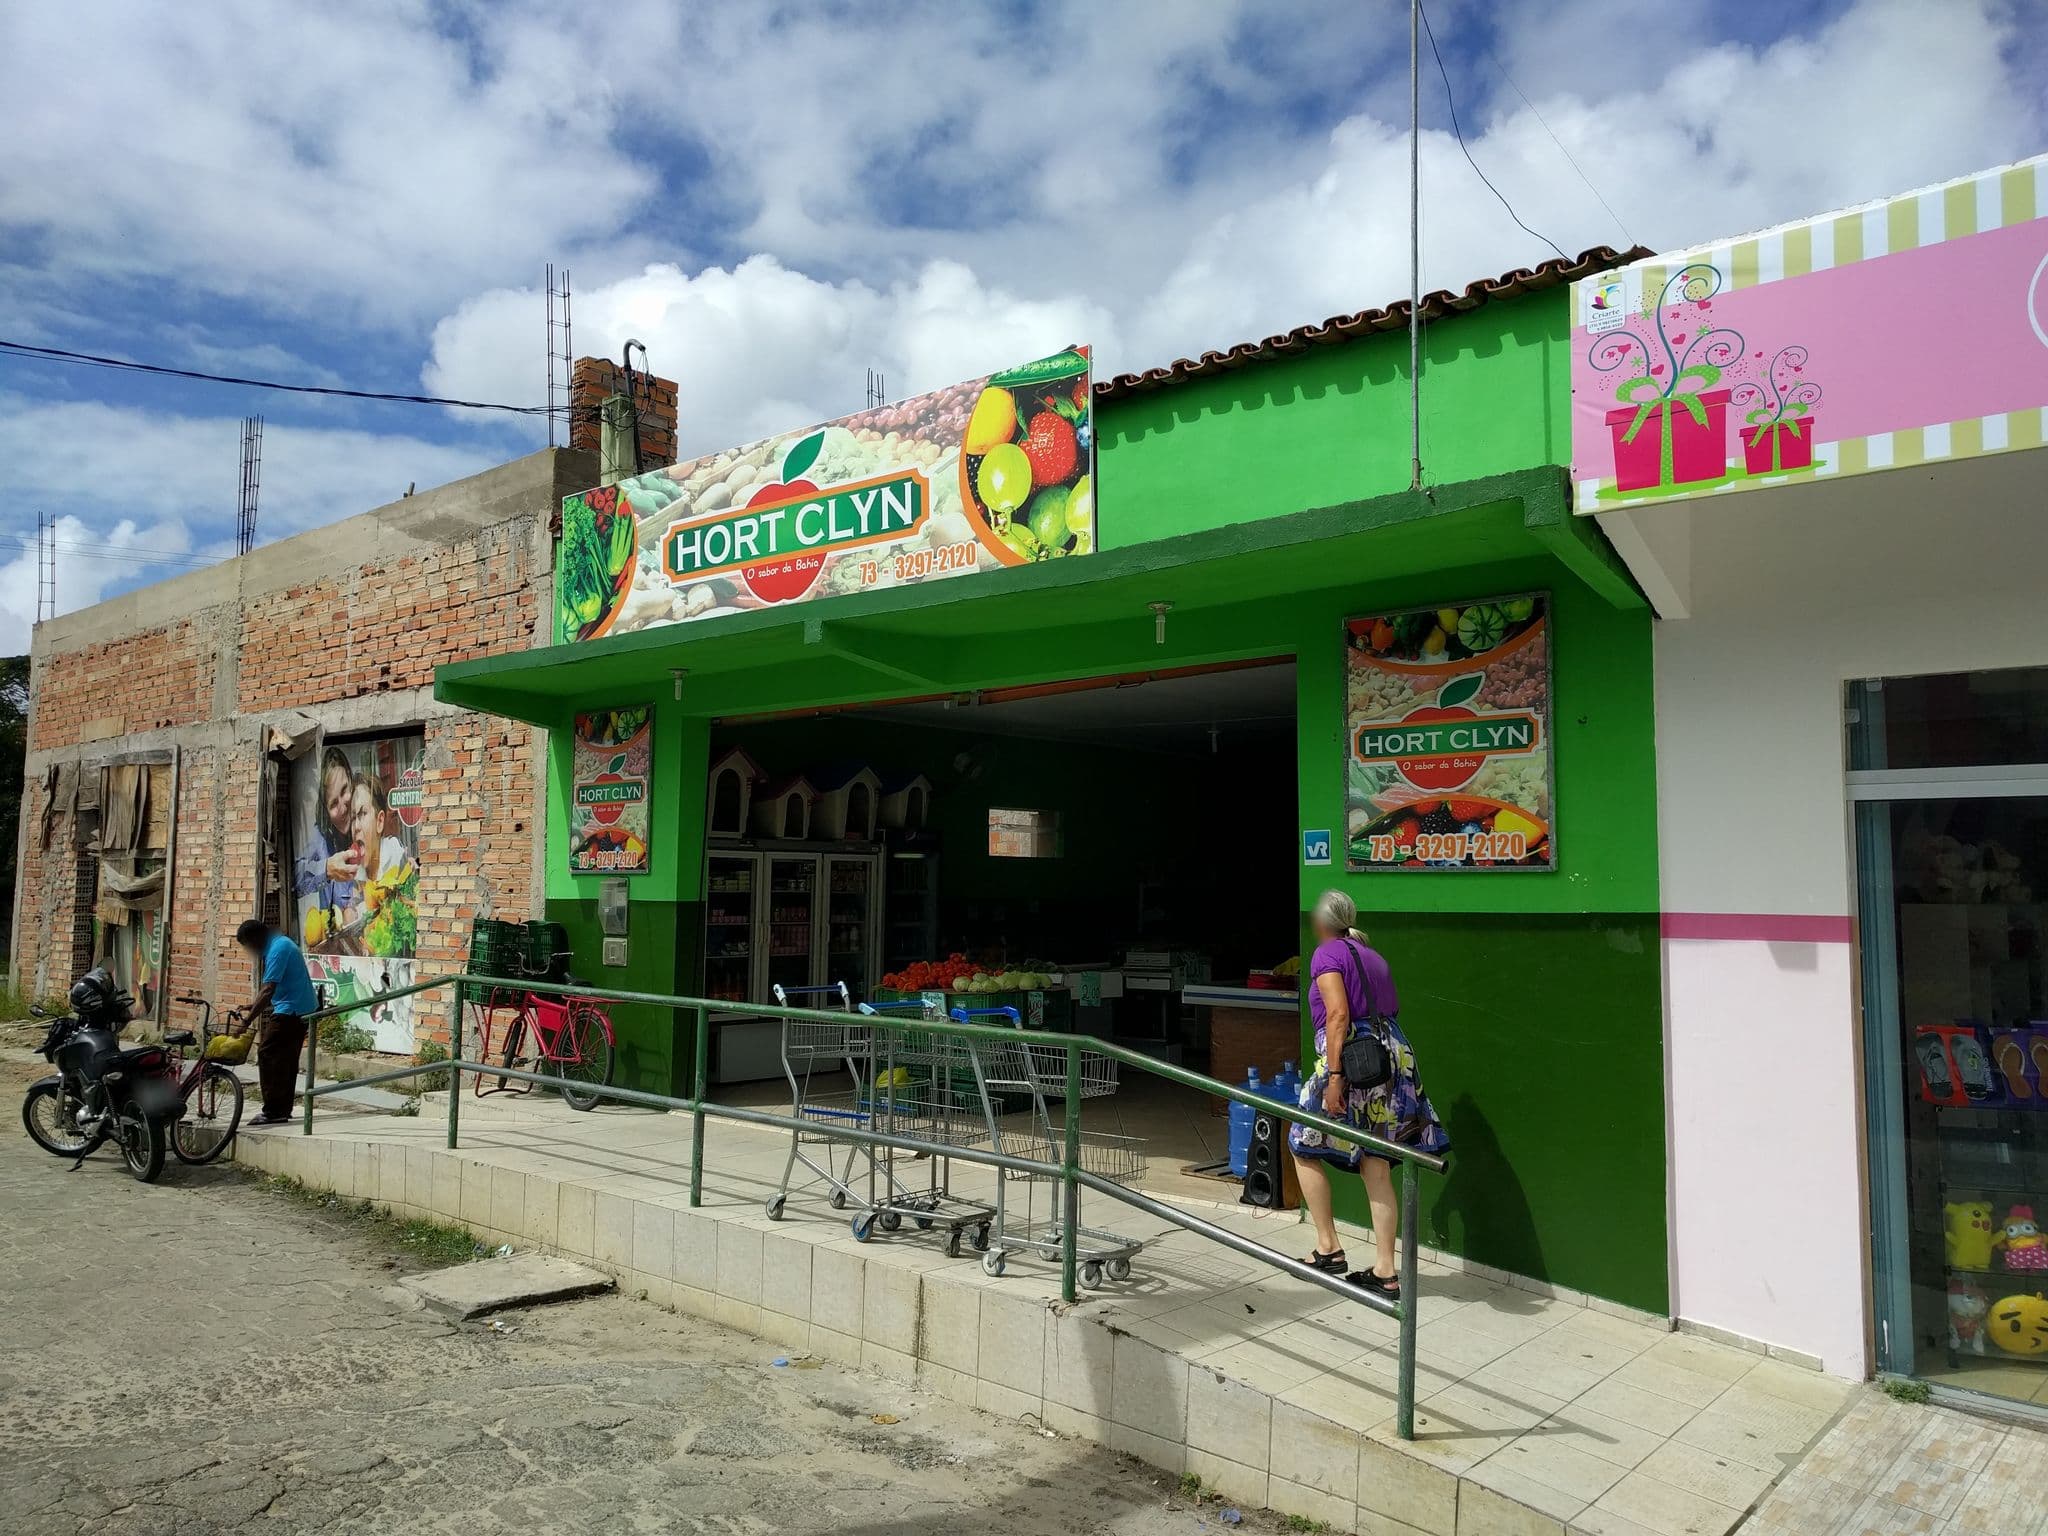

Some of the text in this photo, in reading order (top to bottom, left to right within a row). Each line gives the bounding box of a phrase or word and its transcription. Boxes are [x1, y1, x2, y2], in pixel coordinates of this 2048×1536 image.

[676, 481, 914, 572] HORT CLYN
[747, 558, 819, 579] O sabor da Bahia
[859, 561, 878, 585] 73
[894, 542, 978, 580] 3297-2120
[1364, 725, 1529, 755] HORT CLYN
[1402, 757, 1478, 771] O sabor da Bahia
[579, 785, 642, 802] HORT CLYN
[579, 852, 590, 868] 73
[596, 850, 639, 868] 3297-2120
[1369, 834, 1395, 862] 73
[1415, 832, 1527, 861] 3297-2120
